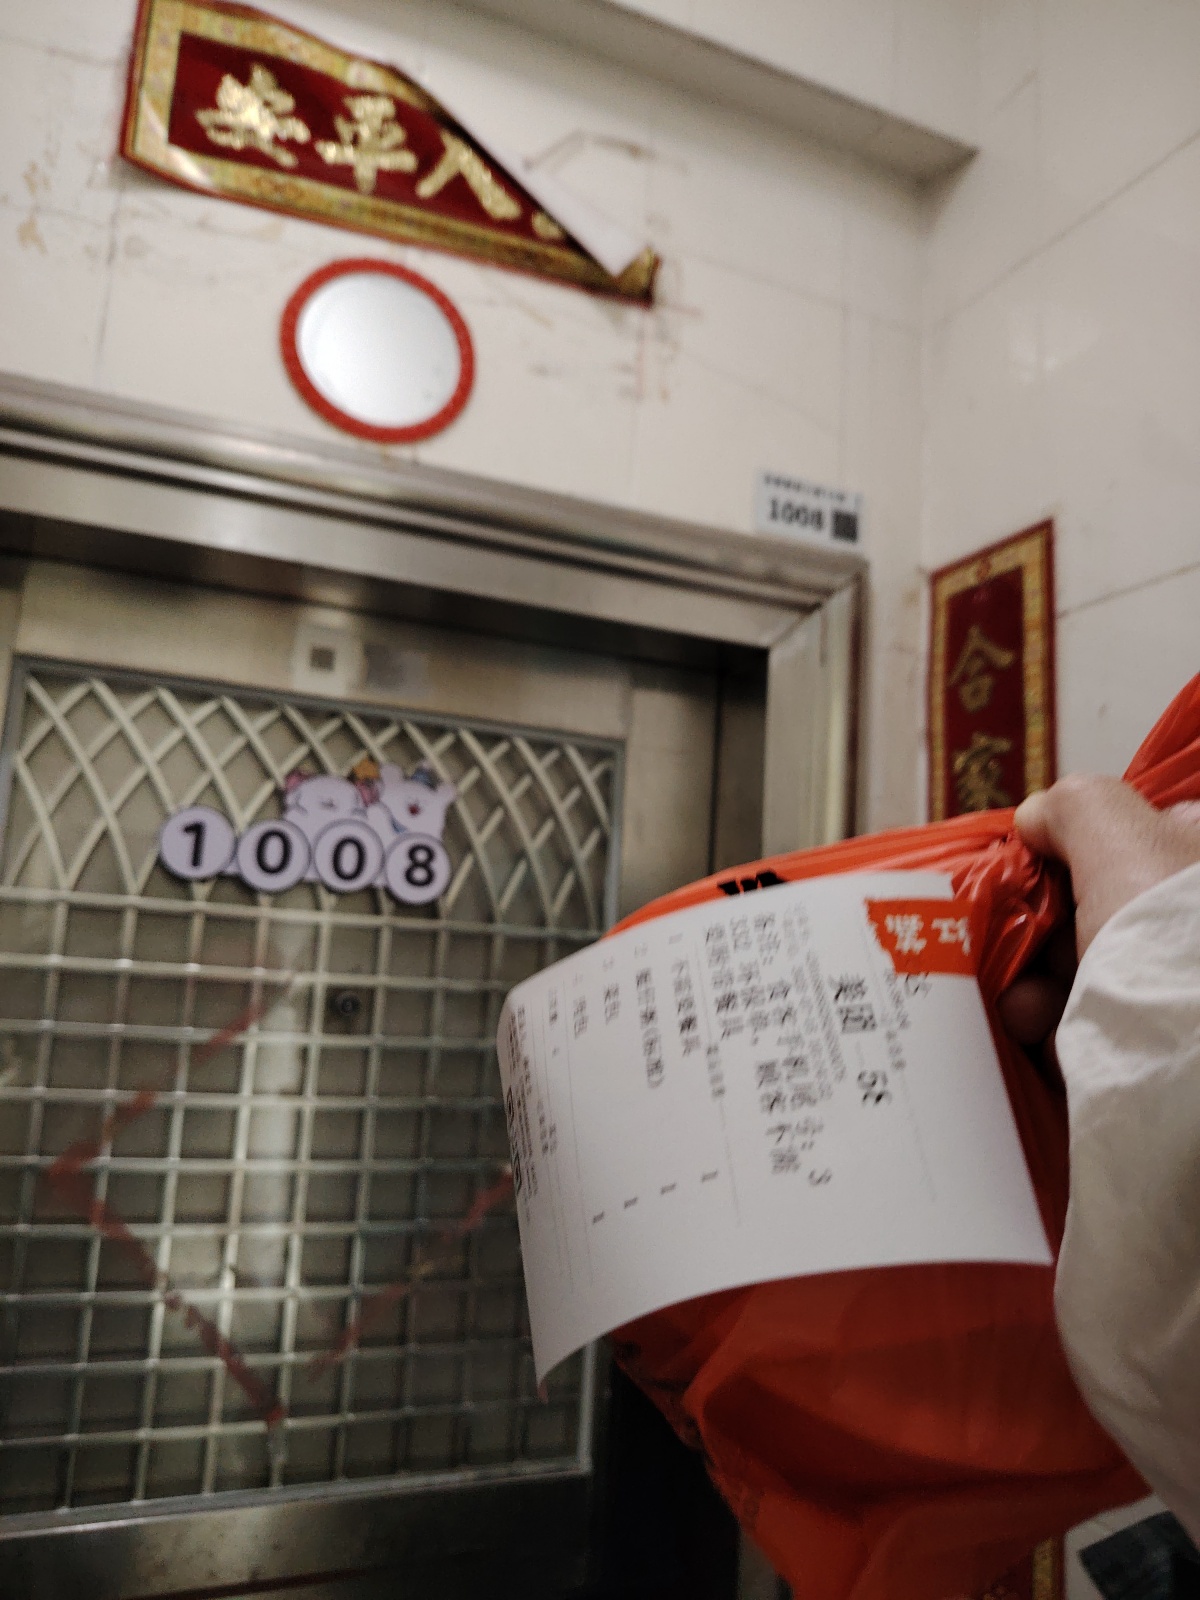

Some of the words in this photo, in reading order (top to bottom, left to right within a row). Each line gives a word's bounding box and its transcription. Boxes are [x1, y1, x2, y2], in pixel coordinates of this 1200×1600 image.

[769, 498, 824, 532] 1008
[182, 821, 435, 888] 1008
[829, 973, 877, 1033] 美团
